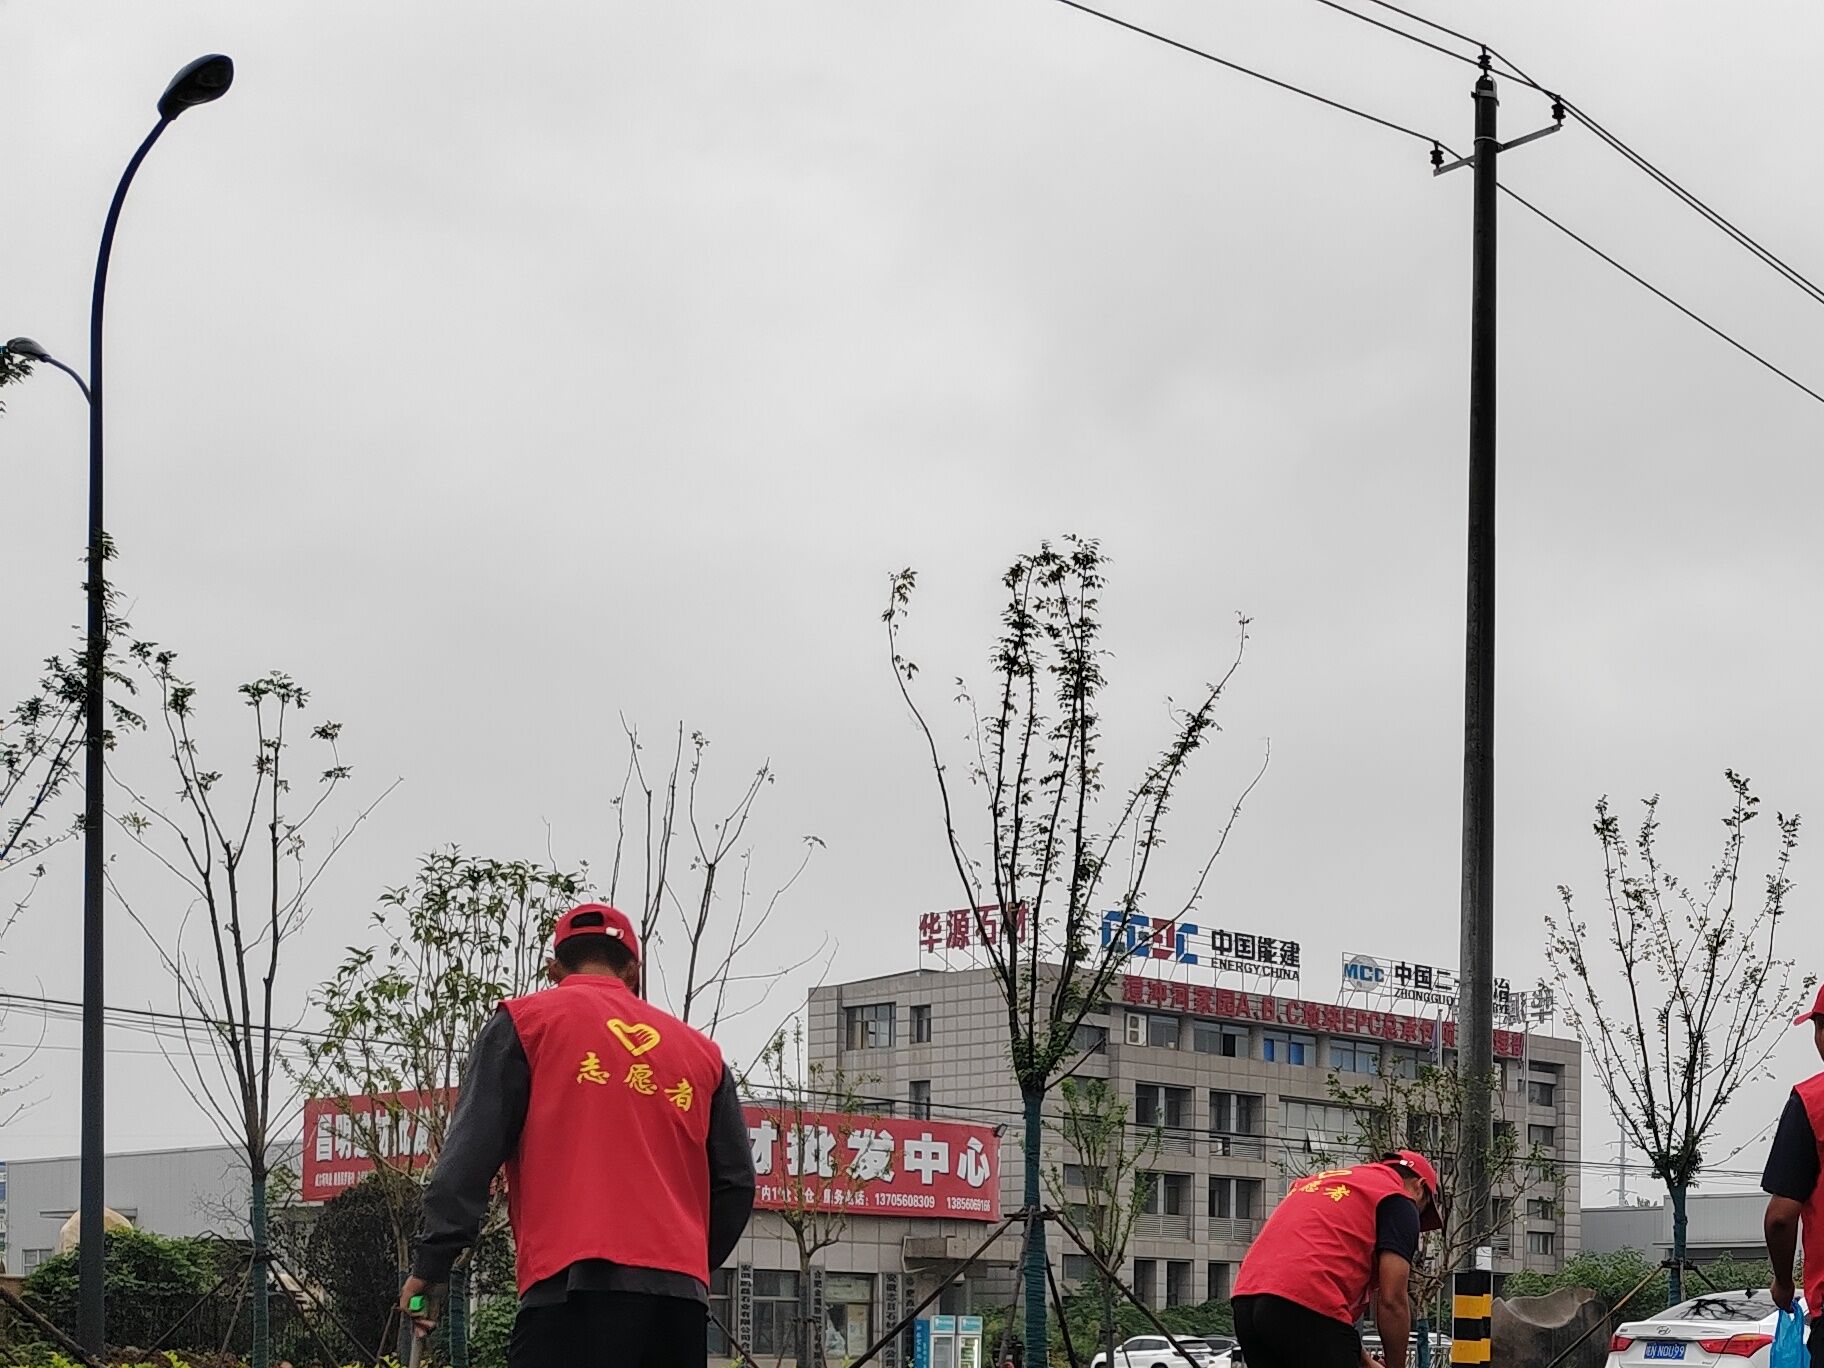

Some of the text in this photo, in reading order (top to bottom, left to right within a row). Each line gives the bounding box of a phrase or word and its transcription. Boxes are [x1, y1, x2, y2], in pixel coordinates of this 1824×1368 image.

[1211, 929, 1300, 968] 中国能建
[1211, 957, 1300, 981] ENERGY CHINA
[1344, 963, 1385, 983] MCC
[576, 1051, 694, 1113] 志愿者
[874, 1192, 936, 1209] 13705608309
